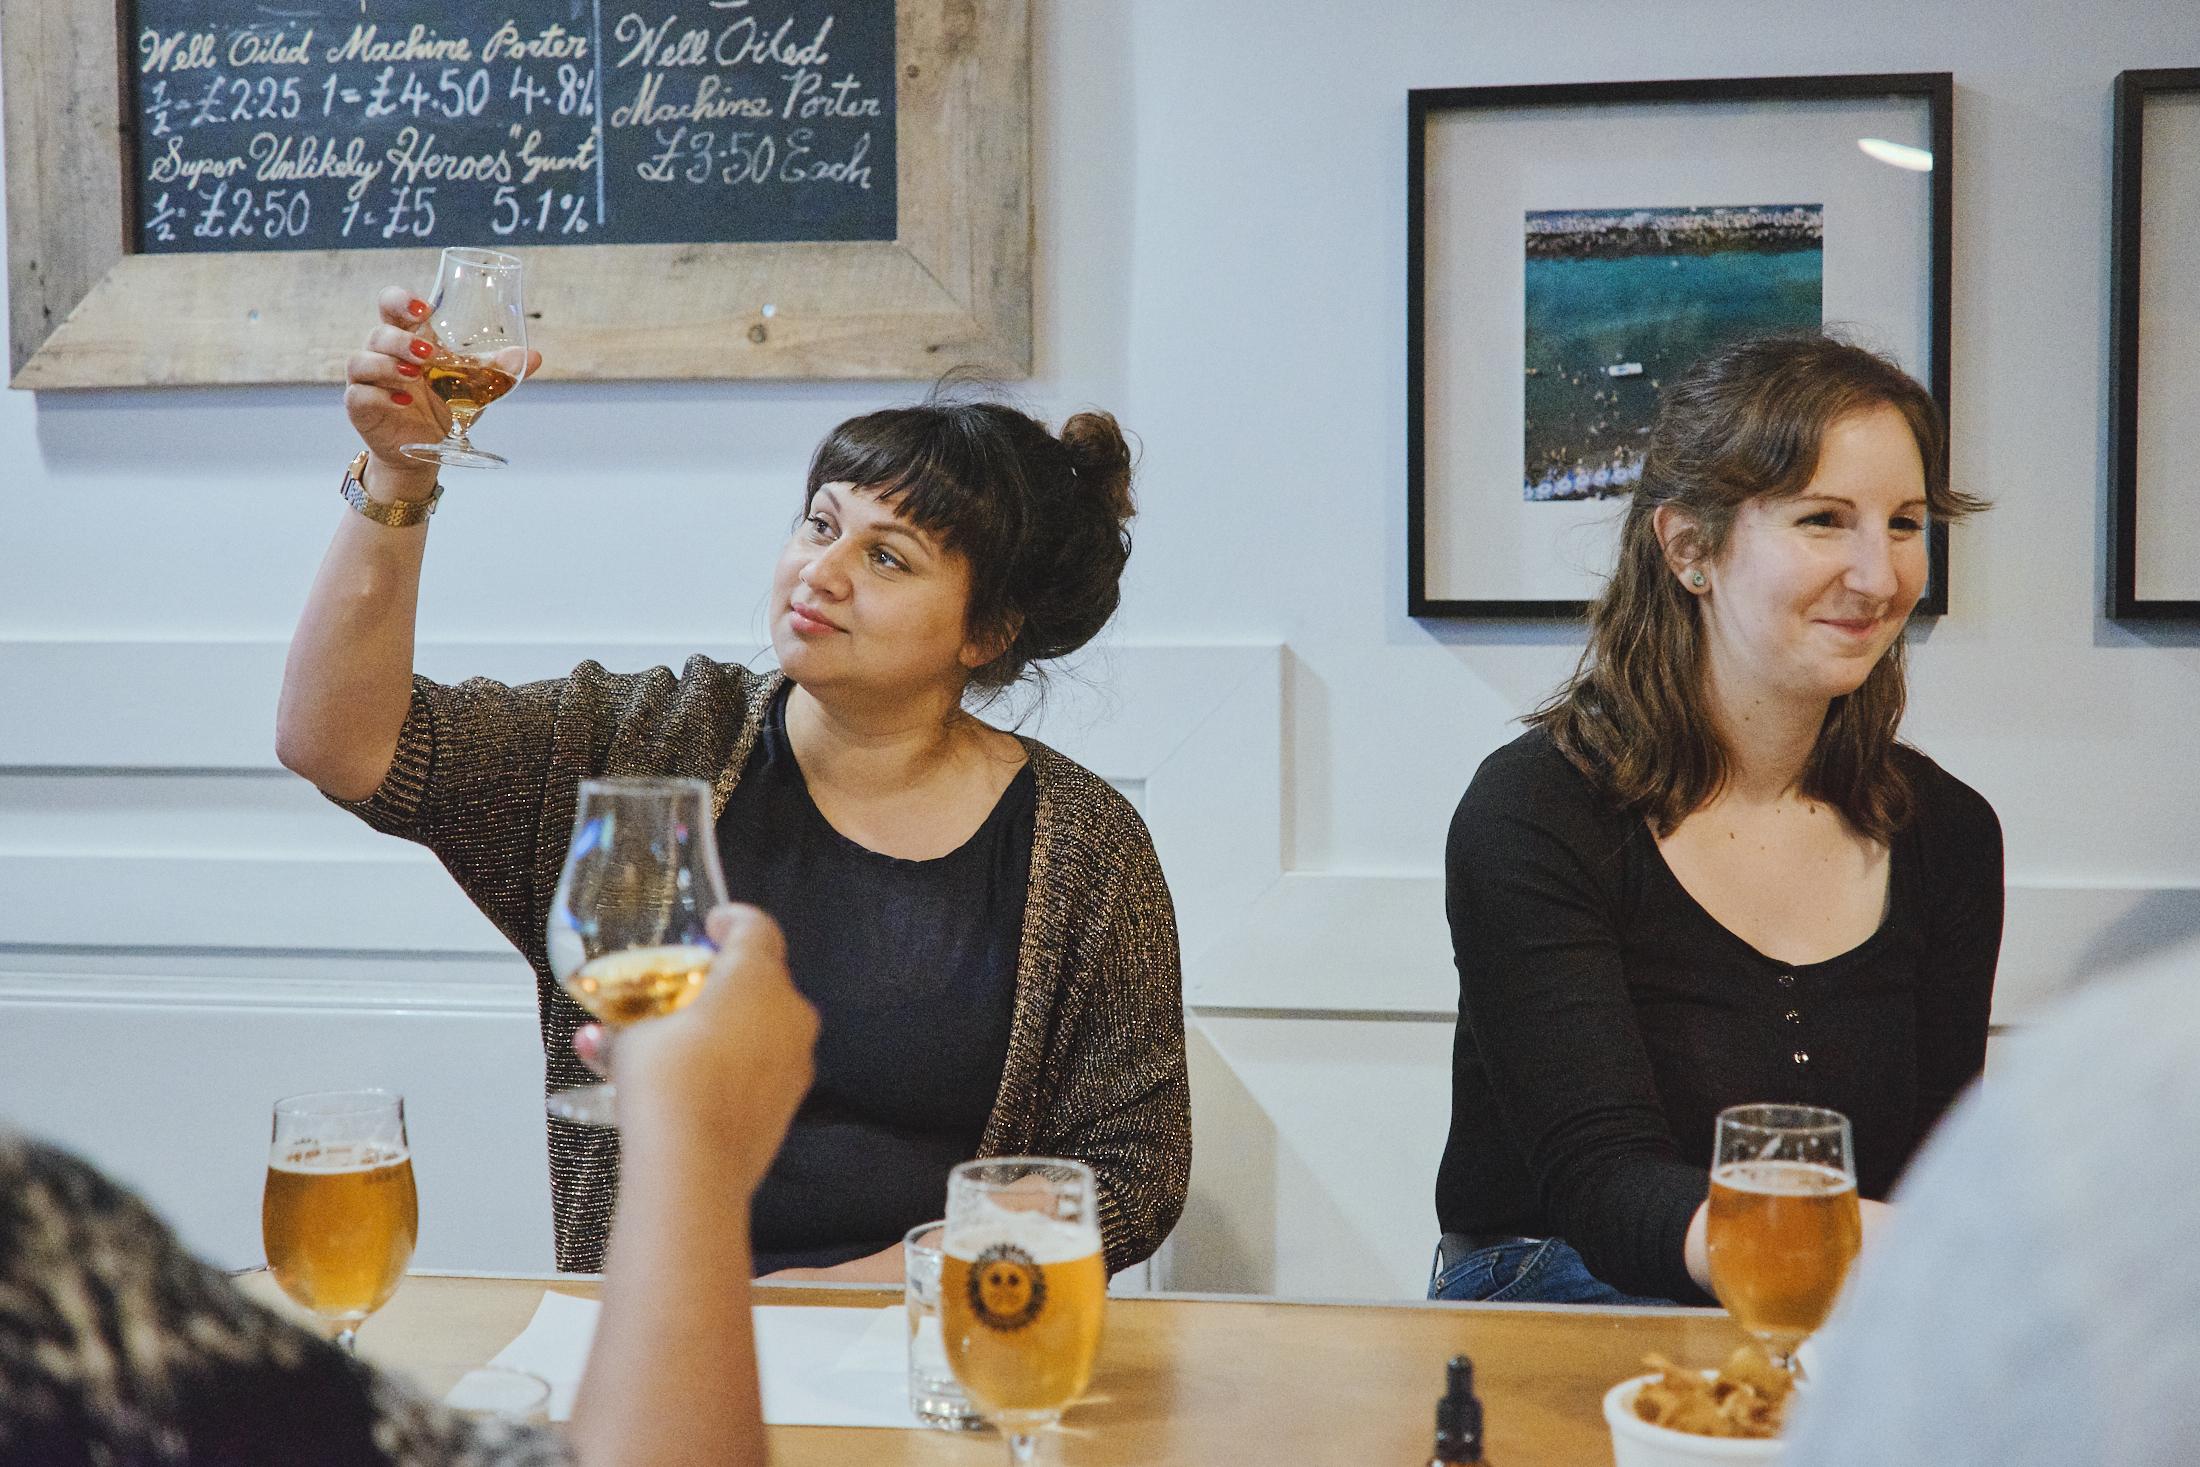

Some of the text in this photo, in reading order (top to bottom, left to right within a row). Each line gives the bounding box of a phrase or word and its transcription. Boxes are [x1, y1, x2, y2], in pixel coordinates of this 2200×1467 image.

[138, 20, 589, 73] Well Oiled Machine Porter
[614, 12, 835, 68] Well Oiled
[610, 67, 882, 129] Machine Porter
[148, 134, 248, 192] Super
[249, 131, 384, 202] Unlikely
[386, 126, 512, 184] Heroes
[779, 126, 872, 190] Each
